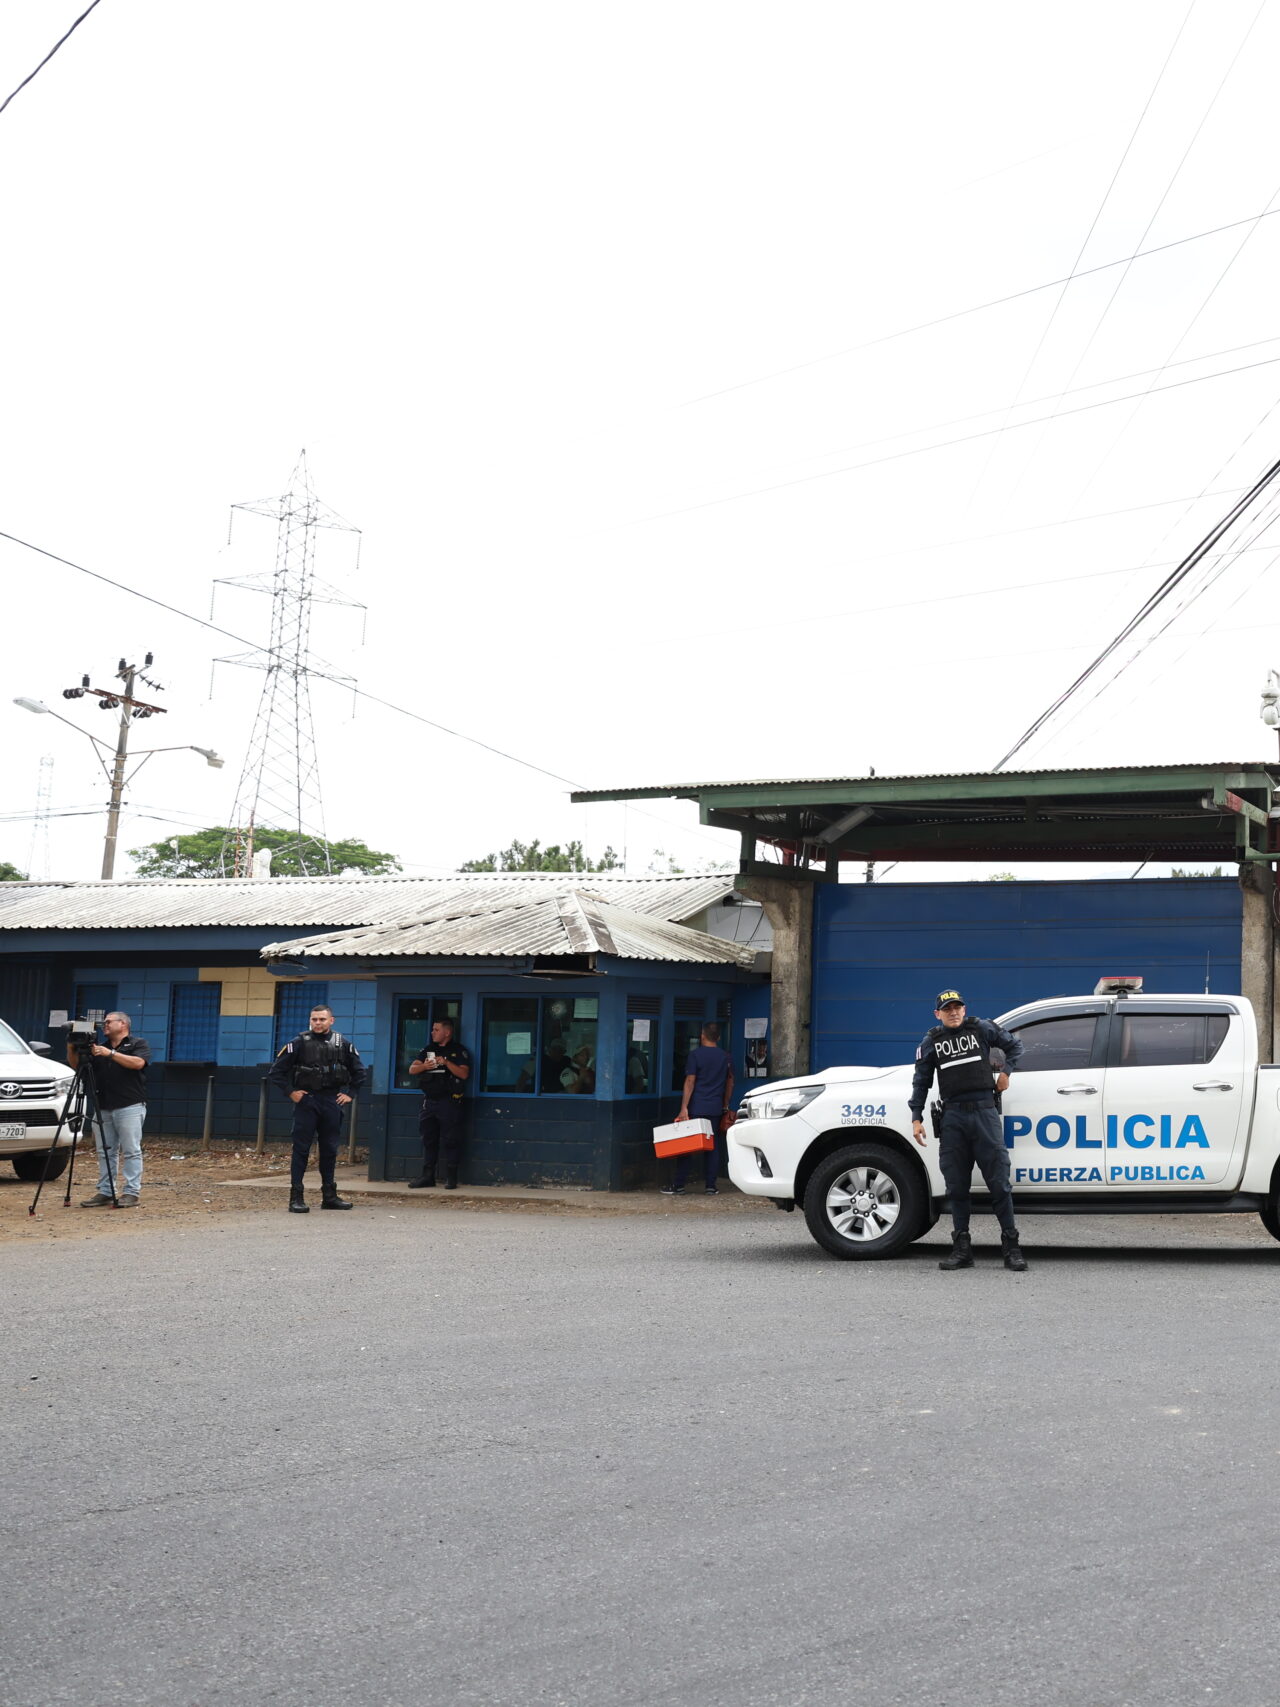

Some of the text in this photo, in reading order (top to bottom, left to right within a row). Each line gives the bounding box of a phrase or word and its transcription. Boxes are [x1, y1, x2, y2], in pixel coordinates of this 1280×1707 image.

[934, 1034, 980, 1058] POLICIA
[841, 1104, 887, 1118] 3494
[841, 1117, 887, 1125] USO OFICIAL
[0, 1127, 24, 1136] -7203
[1003, 1114, 1211, 1149] POLICIA
[1015, 1165, 1206, 1183] FUERZA PUBLICA
